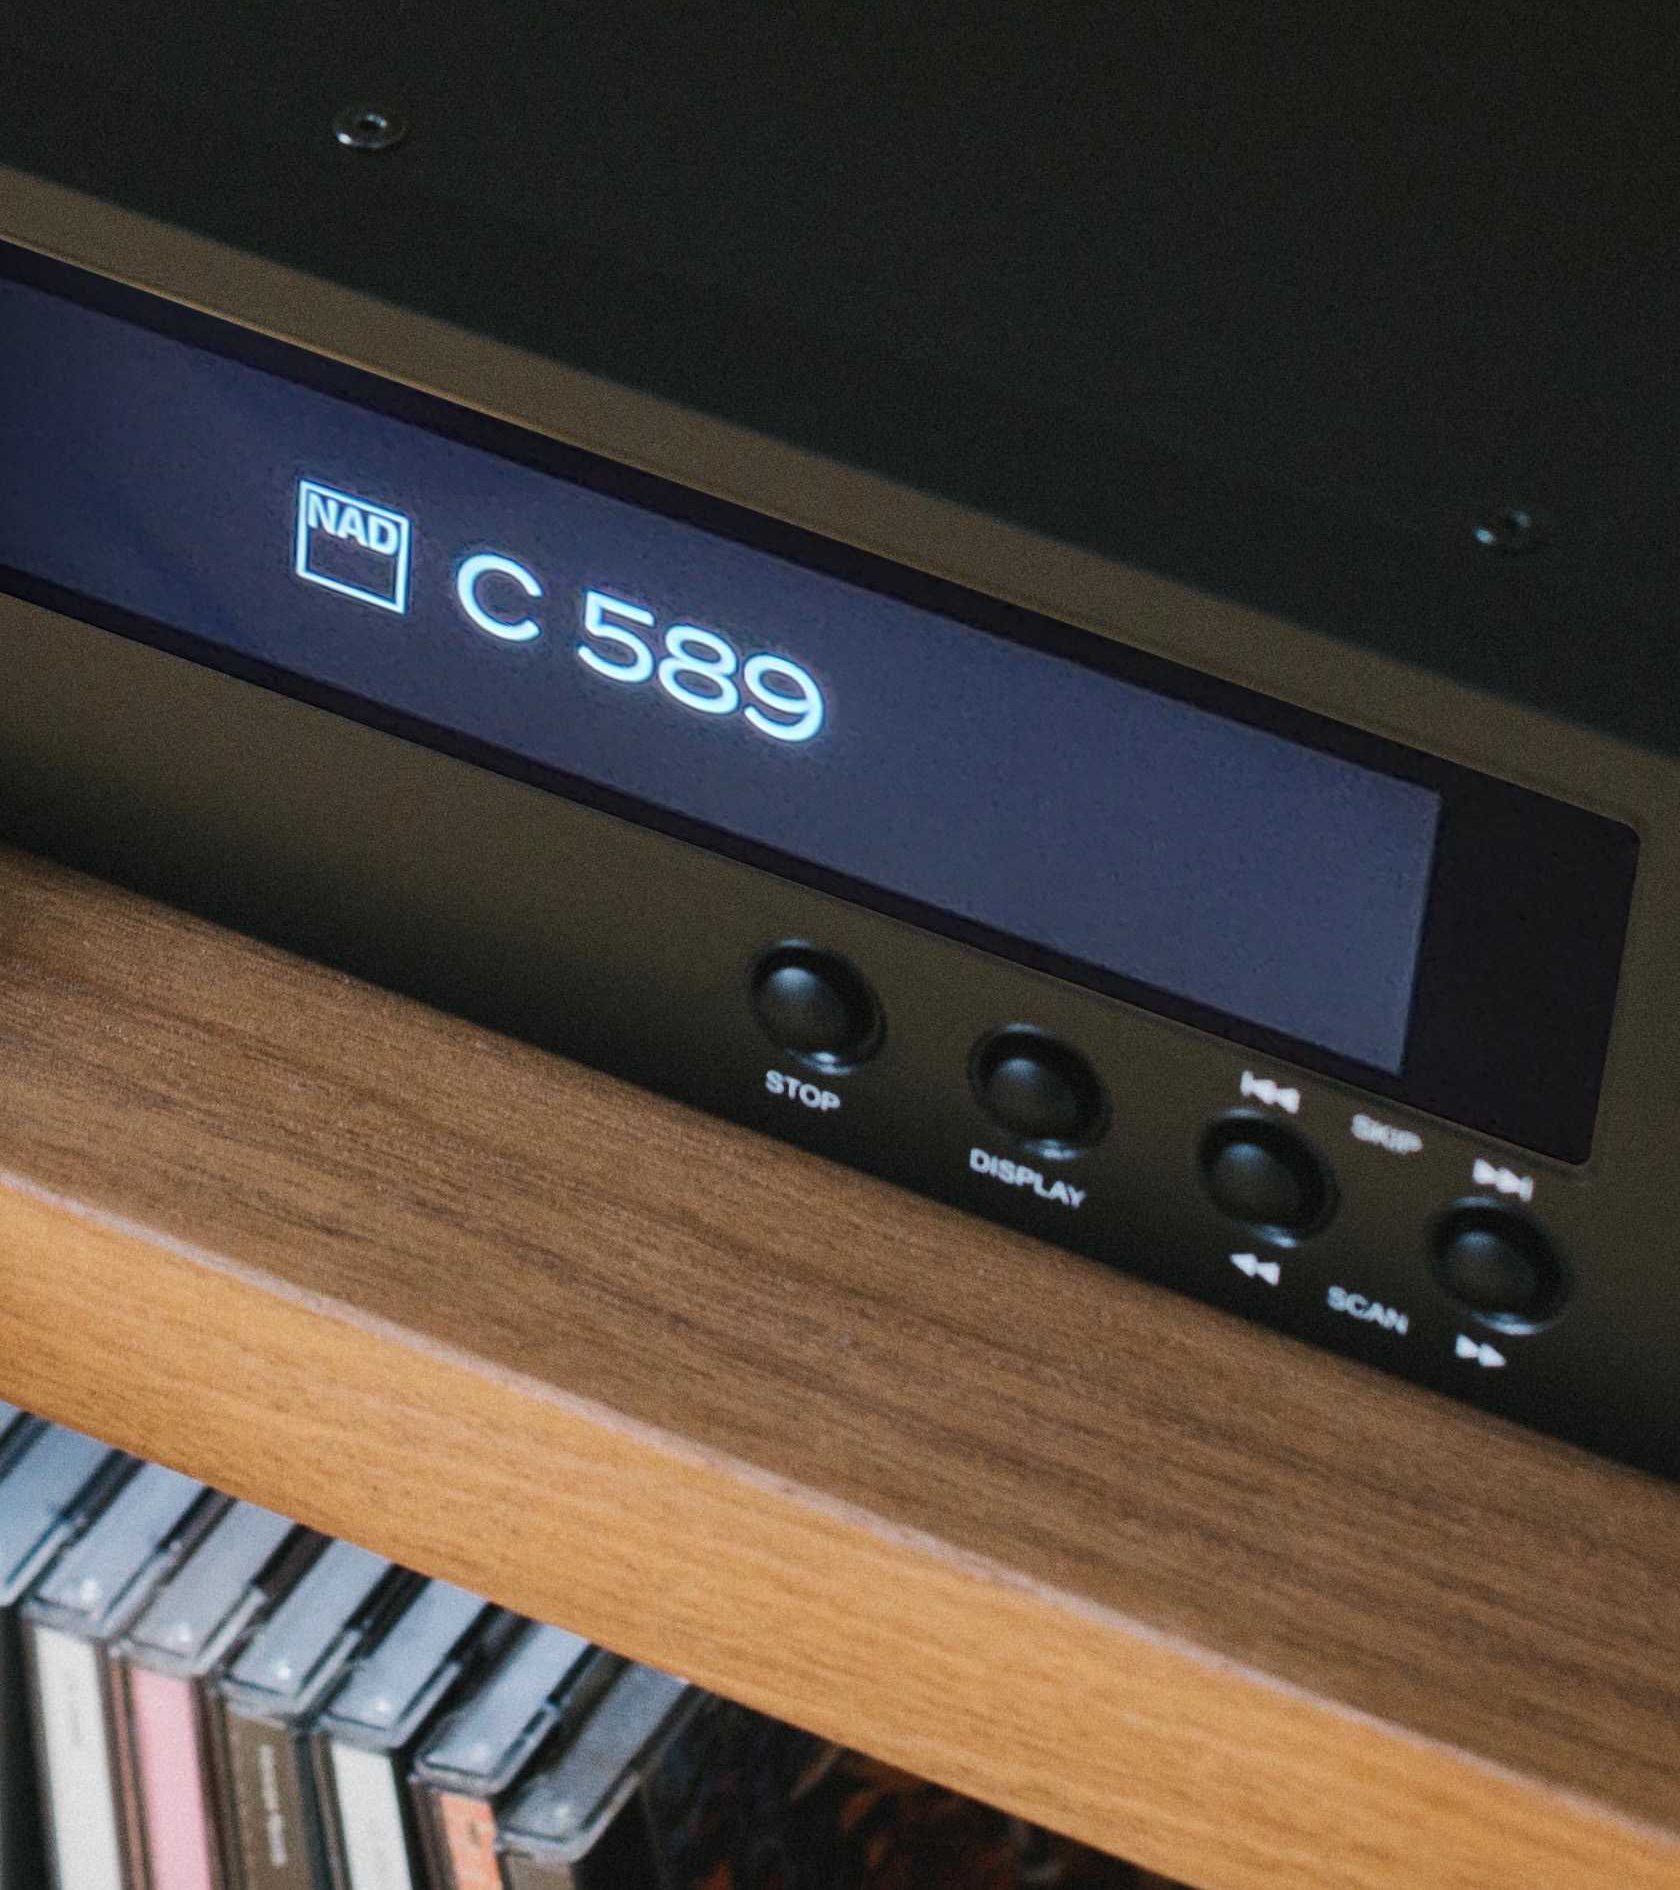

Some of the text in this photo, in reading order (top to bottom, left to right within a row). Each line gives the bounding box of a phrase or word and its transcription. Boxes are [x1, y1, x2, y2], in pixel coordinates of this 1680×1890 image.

[305, 491, 825, 743] NAD C 589
[764, 1069, 841, 1111] STOP
[969, 1147, 1087, 1209] DISPLAY
[1327, 1285, 1409, 1335] SCAN
